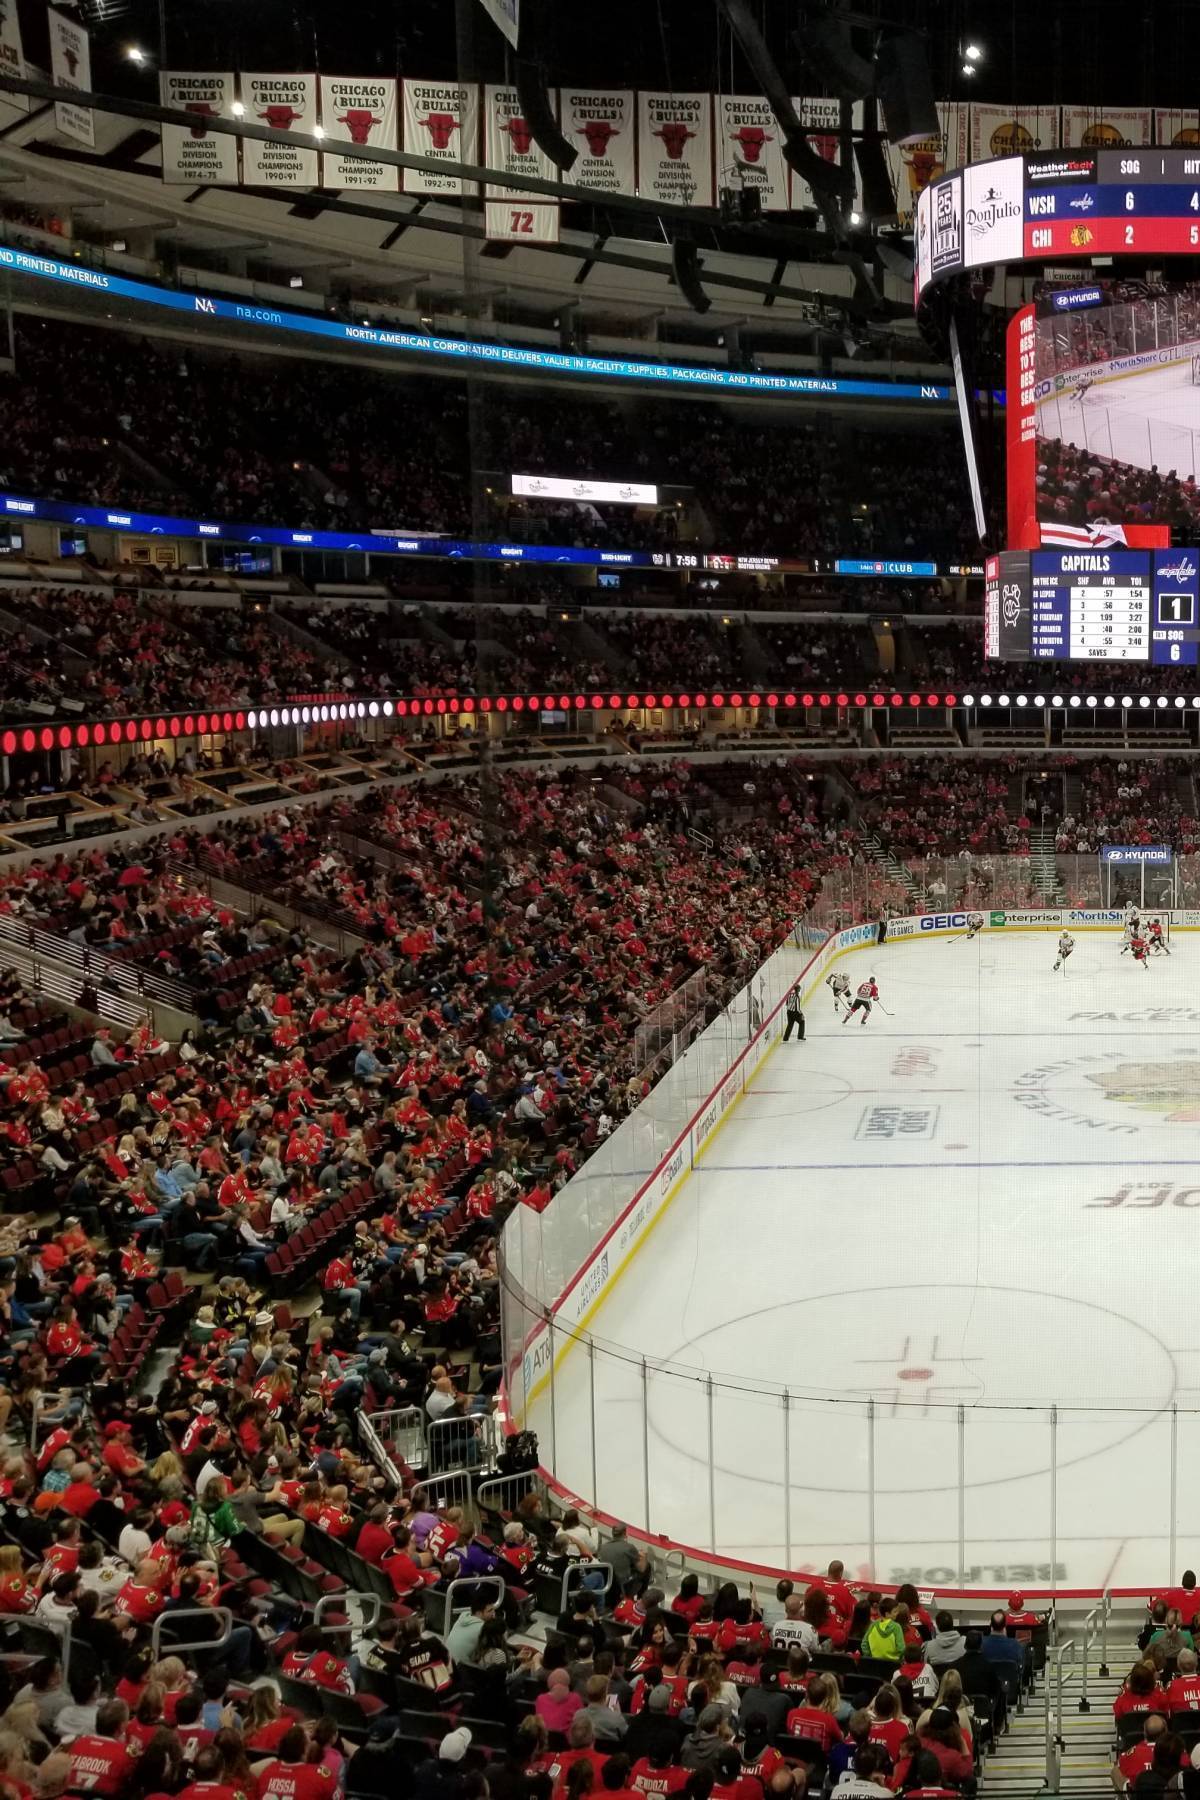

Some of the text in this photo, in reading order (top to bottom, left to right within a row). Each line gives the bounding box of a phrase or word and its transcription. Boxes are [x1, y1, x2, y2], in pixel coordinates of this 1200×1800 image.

[169, 78, 224, 90] CHICAGO
[250, 80, 306, 92] CHICAGO
[178, 90, 217, 101] BULLS
[331, 84, 386, 97] CHICAGO
[413, 87, 468, 101] CHICAGO
[259, 92, 298, 103] BULLS
[339, 96, 379, 108] BULLS
[570, 96, 624, 109] CHICAGO
[421, 100, 461, 113] BULLS
[648, 99, 701, 112] CHICAGO
[578, 108, 618, 120] BULLS
[655, 111, 695, 123] BULLS
[733, 114, 771, 126] BULLS
[182, 150, 217, 159] DIVISION
[262, 151, 298, 161] DIVISION
[424, 149, 457, 159] CENTRAL
[177, 160, 223, 170] CHAMPIONS
[257, 162, 304, 171] CHAMPIONS
[582, 158, 614, 169] CENTRAL
[659, 161, 691, 171] CENTRAL
[1028, 161, 1094, 175] WeatherTech
[1120, 160, 1140, 174] SOG
[183, 170, 217, 179] 1974-75
[264, 171, 298, 181] 1990-91
[337, 167, 384, 177] CHAMPIONS
[580, 169, 615, 179] DIVISION
[658, 172, 692, 181] DIVISION
[344, 175, 378, 185] 1991-92
[423, 179, 457, 189] 1992-93
[576, 178, 621, 189] CHAMPIONS
[938, 194, 952, 217] 25
[1029, 195, 1055, 215] WSH
[1125, 192, 1134, 211] 6
[1190, 192, 1199, 211] 4
[510, 211, 534, 233] 72
[1032, 229, 1052, 248] CHI
[1125, 225, 1134, 244] 2
[1190, 225, 1199, 245] 5
[16, 254, 109, 288] PRINTED MATERIALS
[1069, 291, 1100, 304] HYUNDAI
[236, 304, 282, 324] na.com
[1020, 315, 1033, 334] THE
[345, 327, 838, 391] NORTH AMERICAN CORPORATION DELIVERS VALUE IN FACILITY SUPPLIES, PACKAGING, AND PRINTED MATERIALS
[1112, 354, 1157, 370] NorthShore
[676, 555, 697, 567] 7:56
[1061, 556, 1110, 572] CAPITALS
[889, 564, 913, 573] CLUB
[1078, 577, 1115, 586] SHF AVG
[1171, 597, 1181, 620] 1
[1167, 630, 1184, 641] SOG
[1088, 649, 1107, 657] SAVES
[1170, 644, 1180, 661] 6
[1125, 851, 1167, 860] HYUNDAI
[995, 911, 1061, 925] enterprise
[897, 925, 914, 935] GAMES
[581, 1264, 600, 1297] UNITED
[576, 1280, 600, 1318] AIRLINES
[889, 1563, 1068, 1586] BELFOR
[775, 1628, 802, 1640] GRISWOLD
[409, 1651, 430, 1668] SHARP
[267, 1778, 296, 1793] HOSSA
[635, 1776, 668, 1791] MENDOZA
